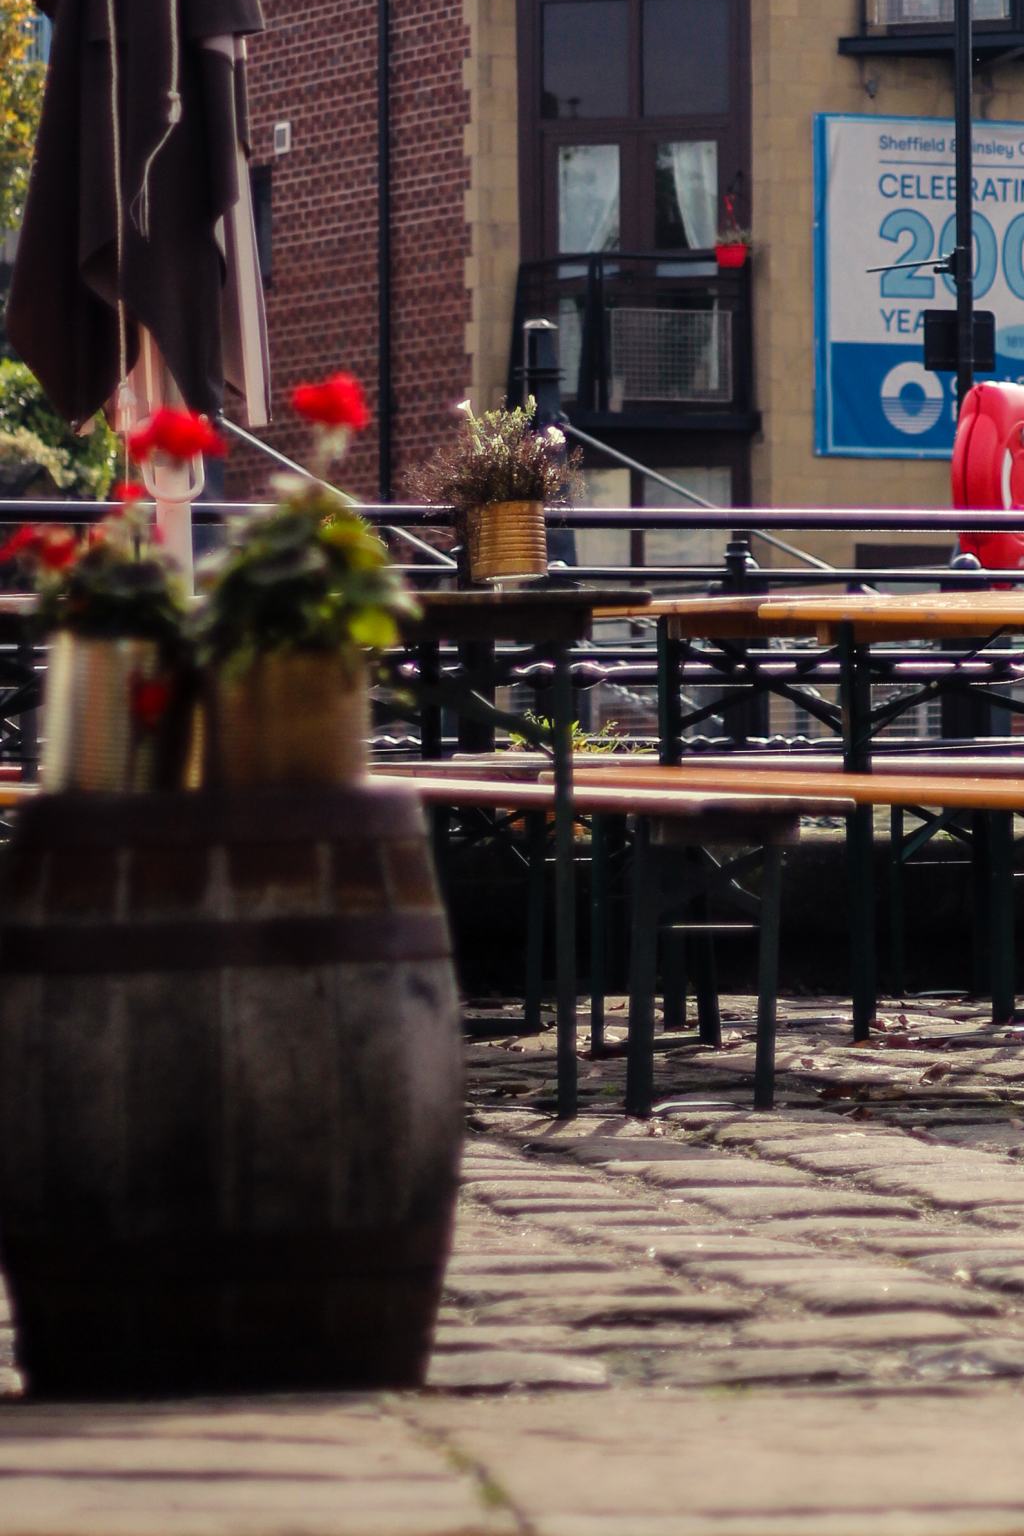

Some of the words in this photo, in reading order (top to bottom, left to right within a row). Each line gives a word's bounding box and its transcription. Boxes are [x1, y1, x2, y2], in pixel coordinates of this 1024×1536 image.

[879, 135, 945, 152] Sheffield
[971, 140, 1014, 159] insley
[880, 309, 925, 333] YEA
